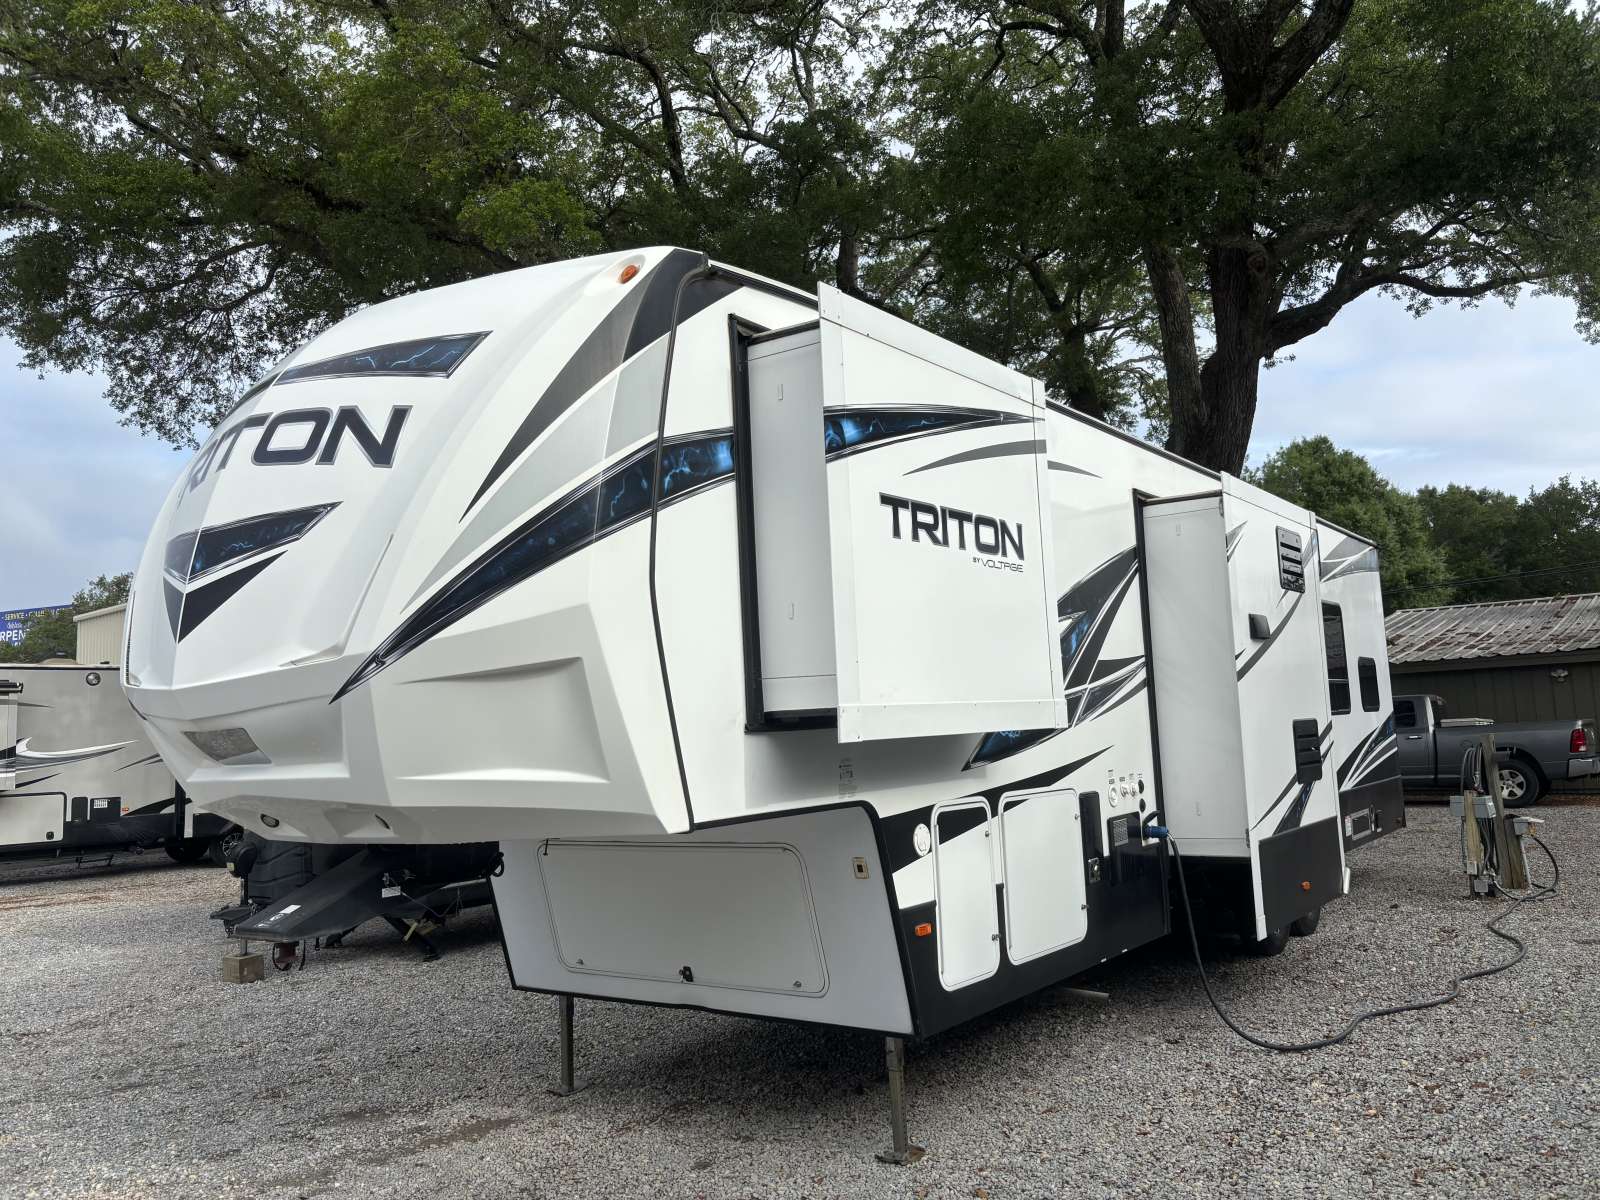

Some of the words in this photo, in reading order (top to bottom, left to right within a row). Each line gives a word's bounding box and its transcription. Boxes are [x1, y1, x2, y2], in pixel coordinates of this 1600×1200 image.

[879, 492, 1025, 561] TRITON
[981, 558, 1024, 573] VOLTAGE
[0, 629, 30, 641] RPEN
